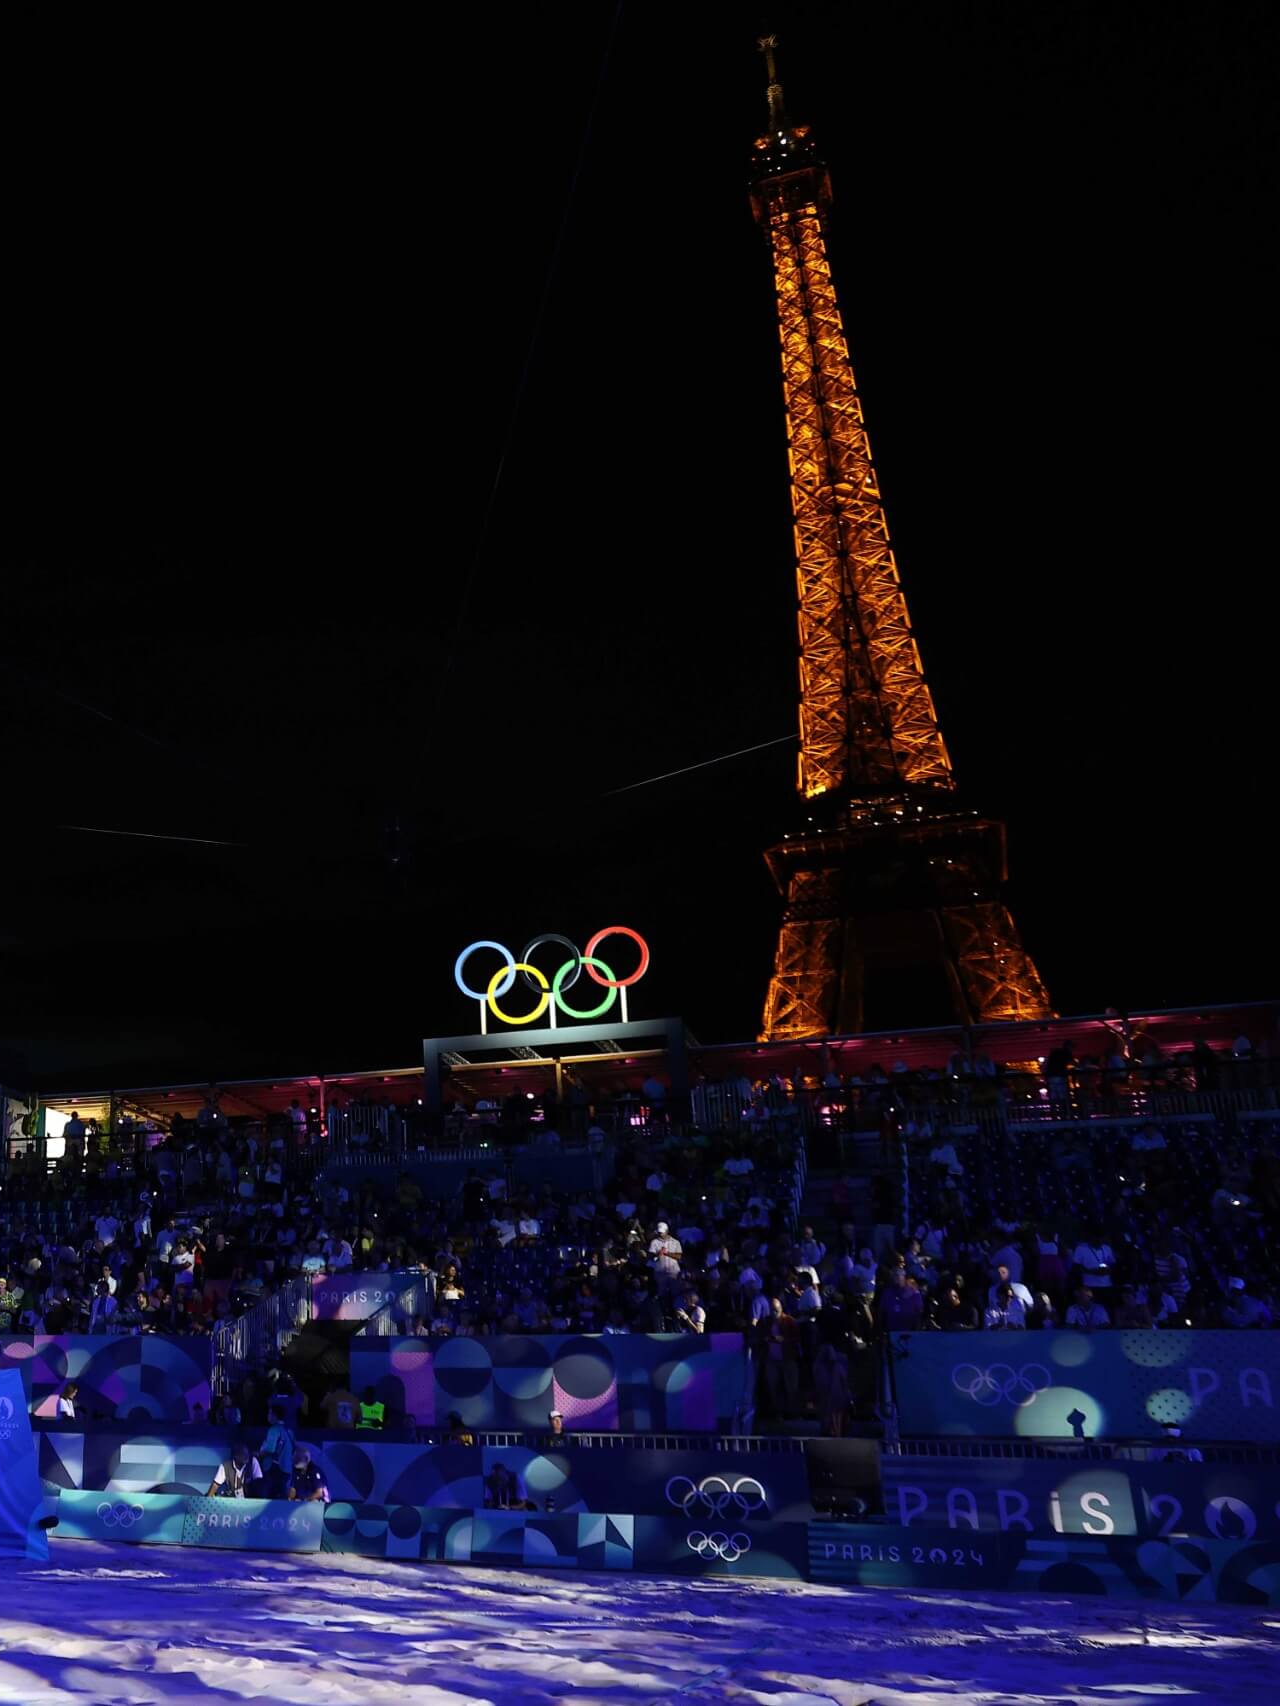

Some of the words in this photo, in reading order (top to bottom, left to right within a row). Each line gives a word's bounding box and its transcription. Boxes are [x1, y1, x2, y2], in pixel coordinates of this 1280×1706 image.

[897, 1486, 1115, 1535] PARiS
[1150, 1493, 1280, 1540] 20
[261, 1517, 311, 1532] 2024
[912, 1546, 984, 1567] 2024
